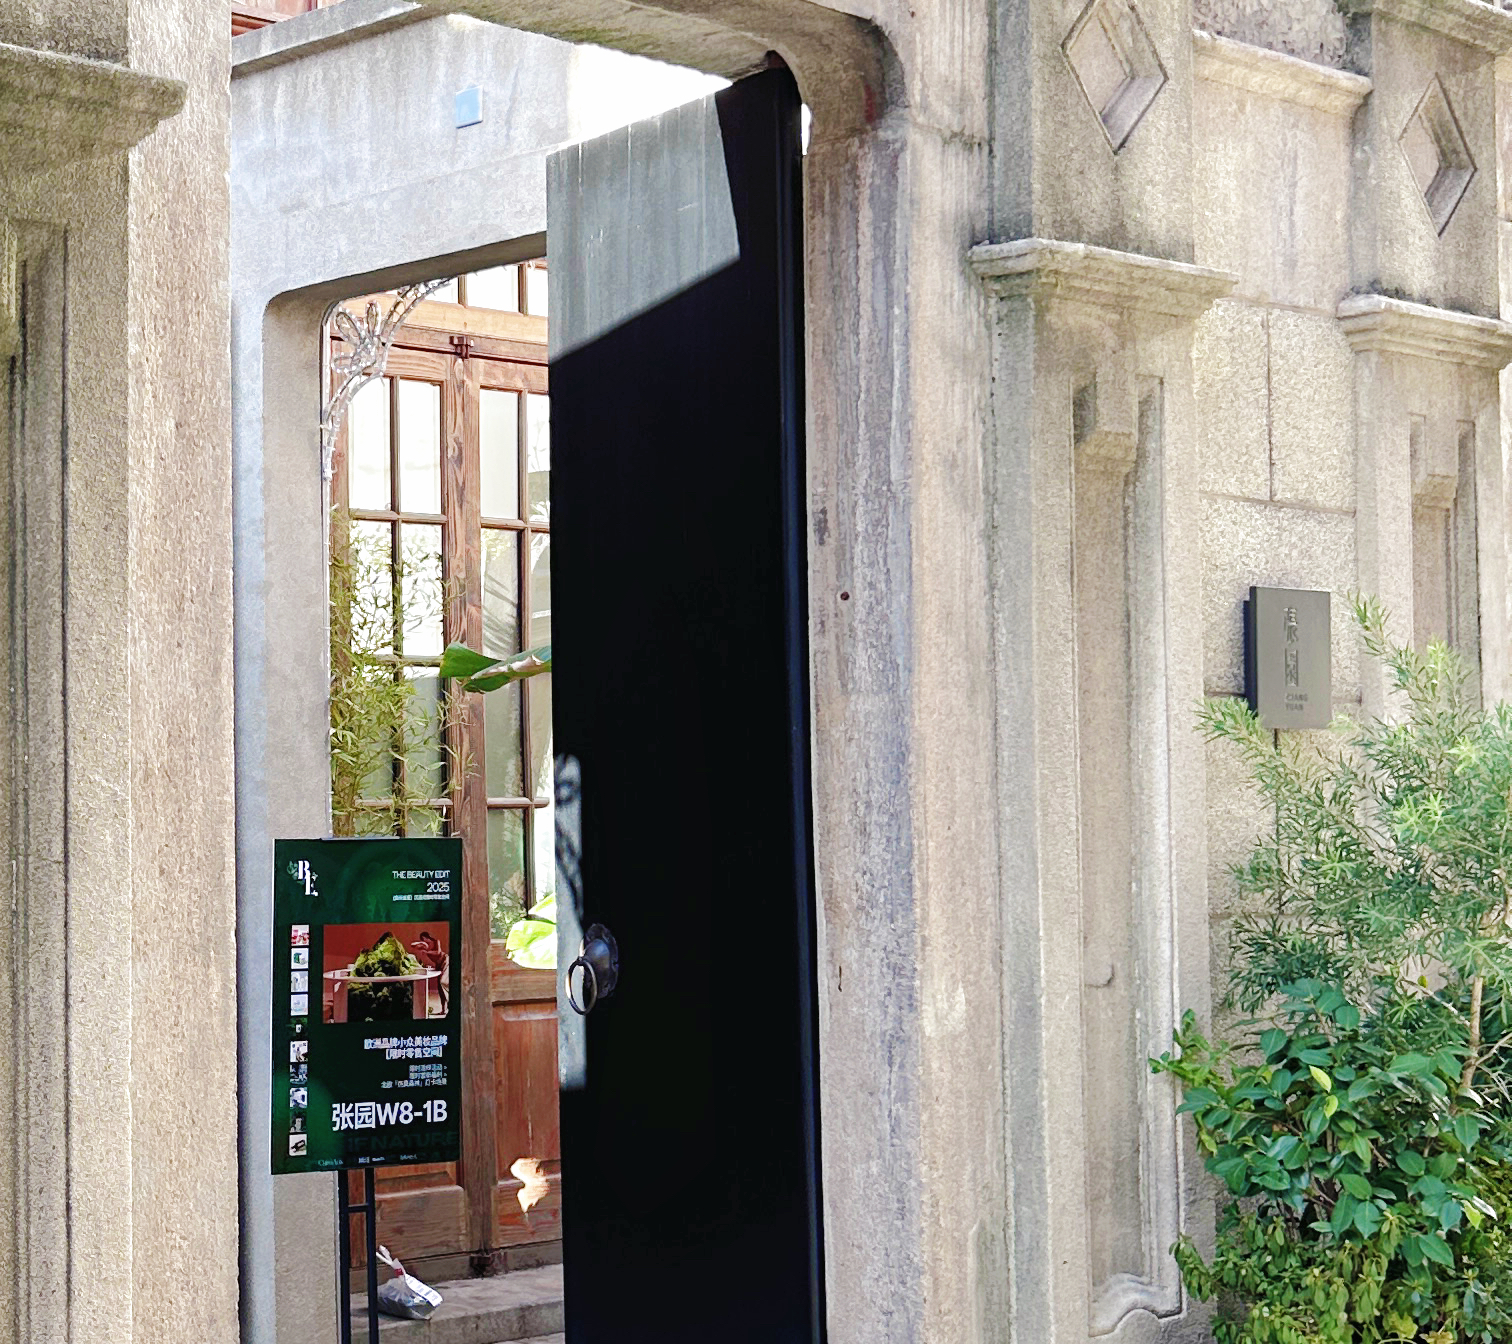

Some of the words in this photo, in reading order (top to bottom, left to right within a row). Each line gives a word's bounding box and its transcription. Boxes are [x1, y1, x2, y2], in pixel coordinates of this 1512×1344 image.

[392, 870, 406, 879] THE
[407, 870, 434, 879] BEAUTY
[426, 882, 450, 893] 2025
